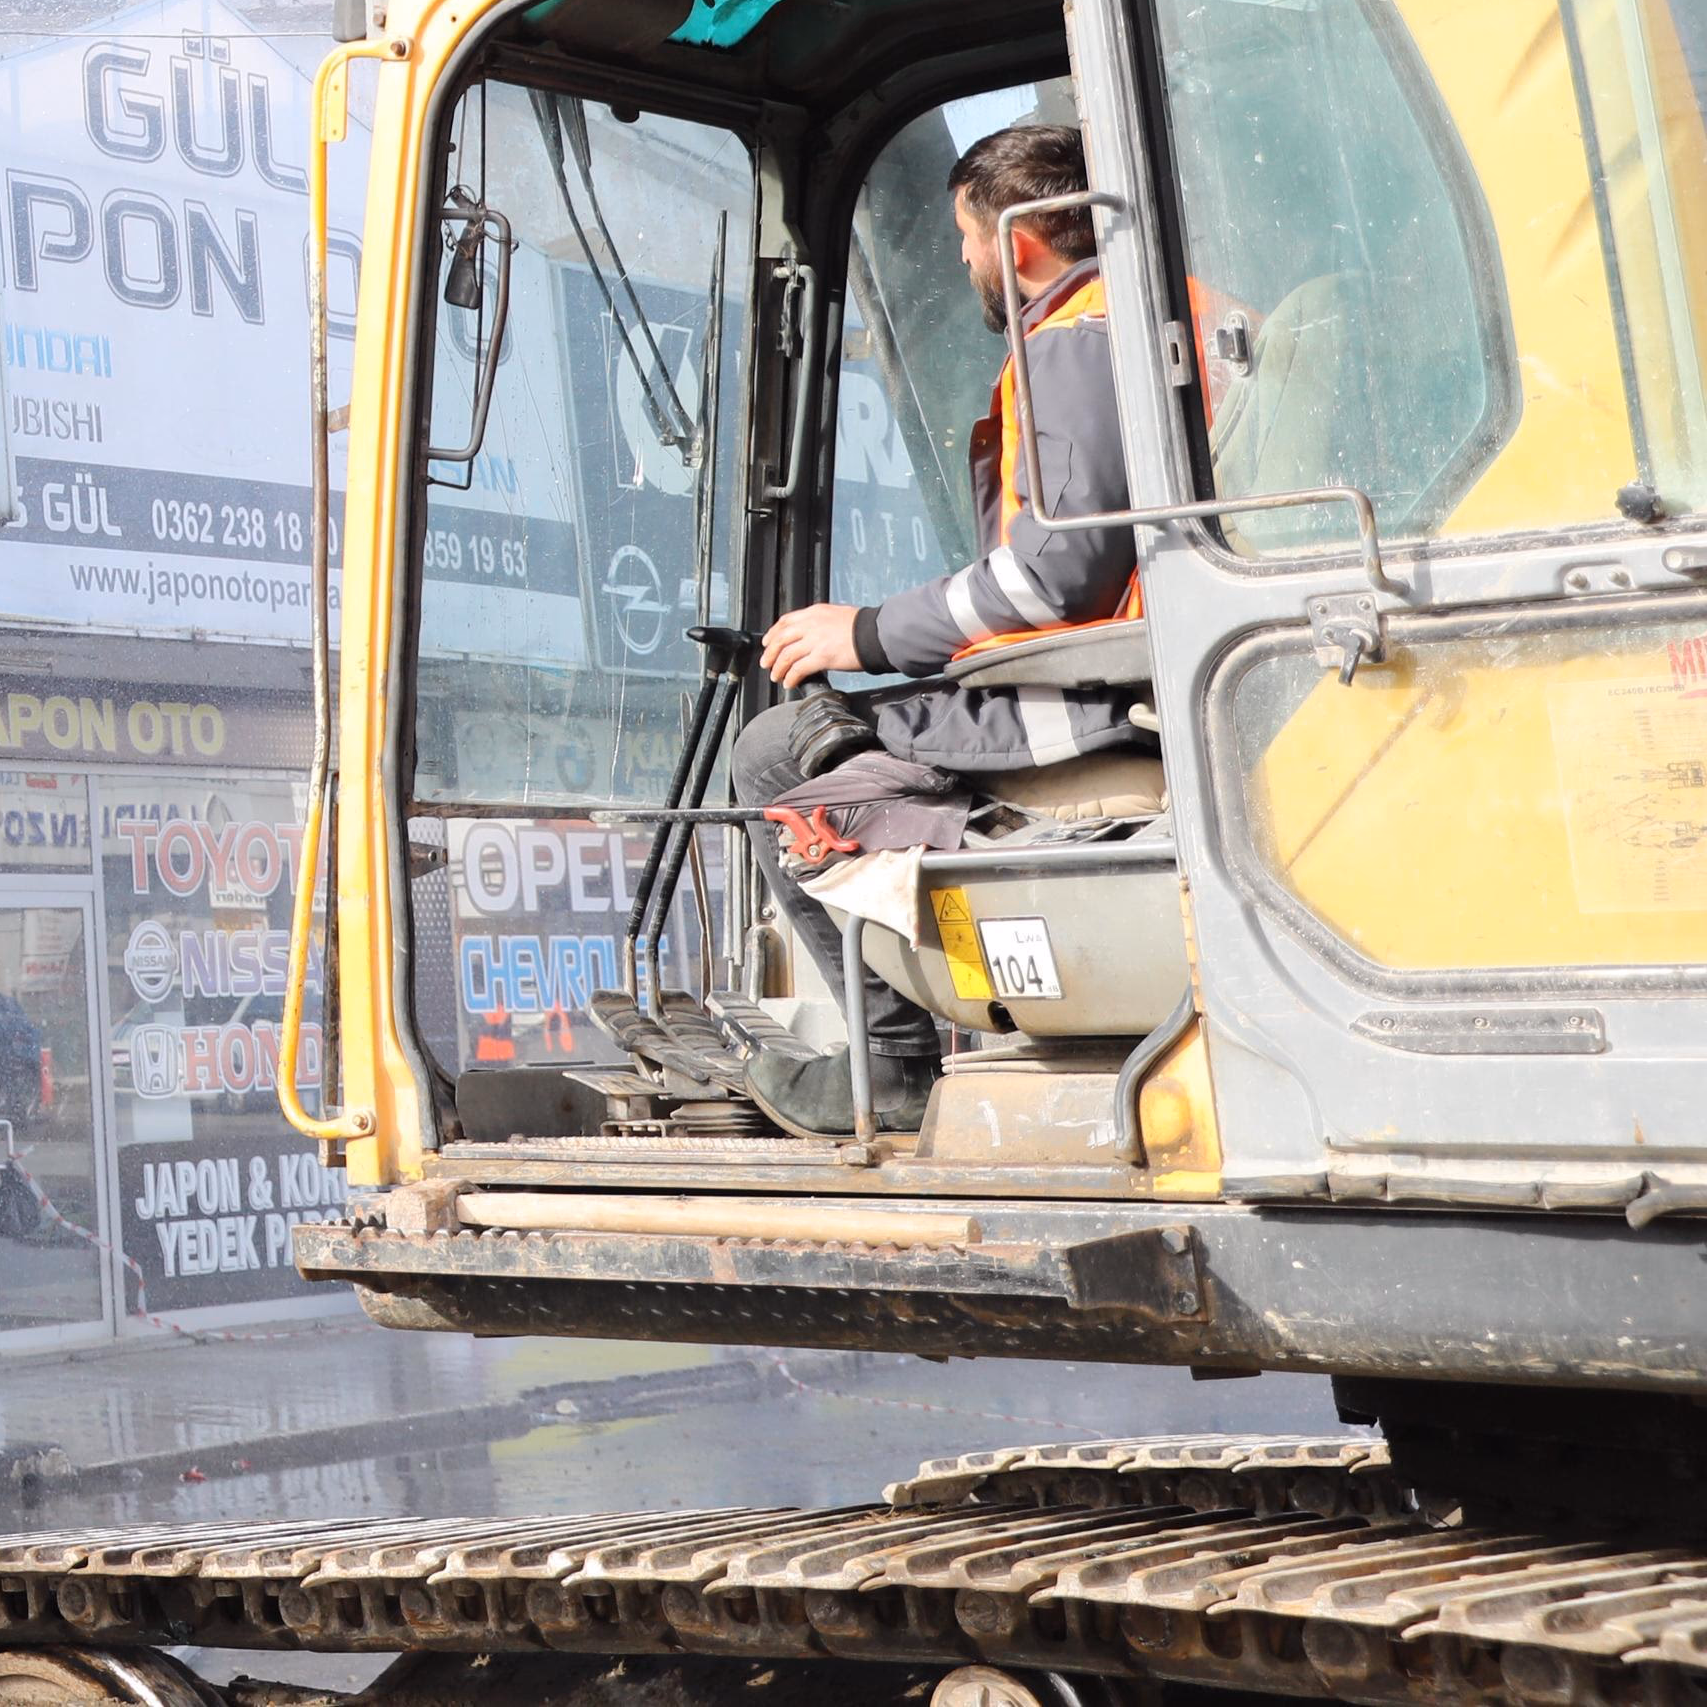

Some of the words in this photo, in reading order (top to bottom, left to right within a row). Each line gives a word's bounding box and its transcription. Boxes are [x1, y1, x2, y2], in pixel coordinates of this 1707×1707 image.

[83, 28, 313, 194] GÜL
[42, 471, 123, 537] GÜL
[151, 498, 215, 543] 0362
[221, 504, 267, 549] 238
[274, 510, 303, 552] 18
[468, 535, 495, 575] 19
[501, 542, 527, 578] 63
[70, 561, 341, 613] www.japonotopara
[128, 702, 227, 756] OTO
[117, 818, 327, 897] TOYOT
[463, 823, 639, 918] OPEL
[132, 954, 172, 968] NISSAN
[992, 954, 1044, 995] 104
[179, 1024, 325, 1093] HOND
[136, 1158, 241, 1221] JAPON
[248, 1155, 274, 1212] &
[156, 1214, 262, 1278] YEDEK
